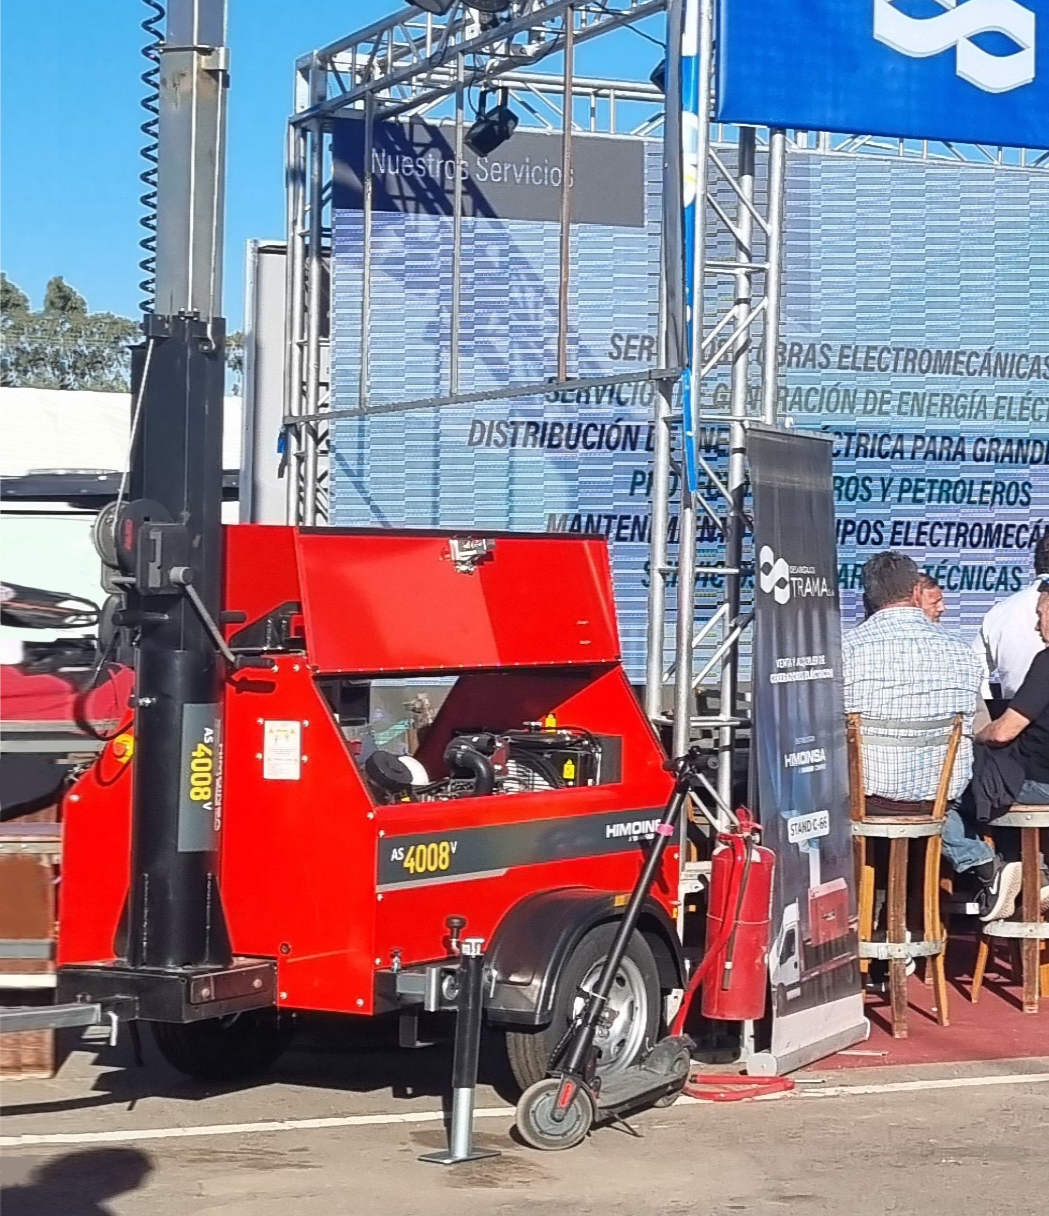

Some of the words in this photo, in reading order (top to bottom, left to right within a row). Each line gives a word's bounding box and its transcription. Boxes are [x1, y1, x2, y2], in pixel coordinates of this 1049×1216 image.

[862, 388, 892, 416] DE
[896, 387, 988, 421] ENERGÍA
[467, 418, 643, 452] DISTRIBUCIÓN
[911, 434, 966, 463] PARA
[880, 475, 896, 503] Y
[898, 476, 1033, 507] PETROLEROS
[790, 576, 828, 598] TRAMA
[204, 727, 214, 744] AS
[189, 743, 213, 801] 4008
[390, 847, 405, 862] AS
[403, 841, 450, 875] 4008
